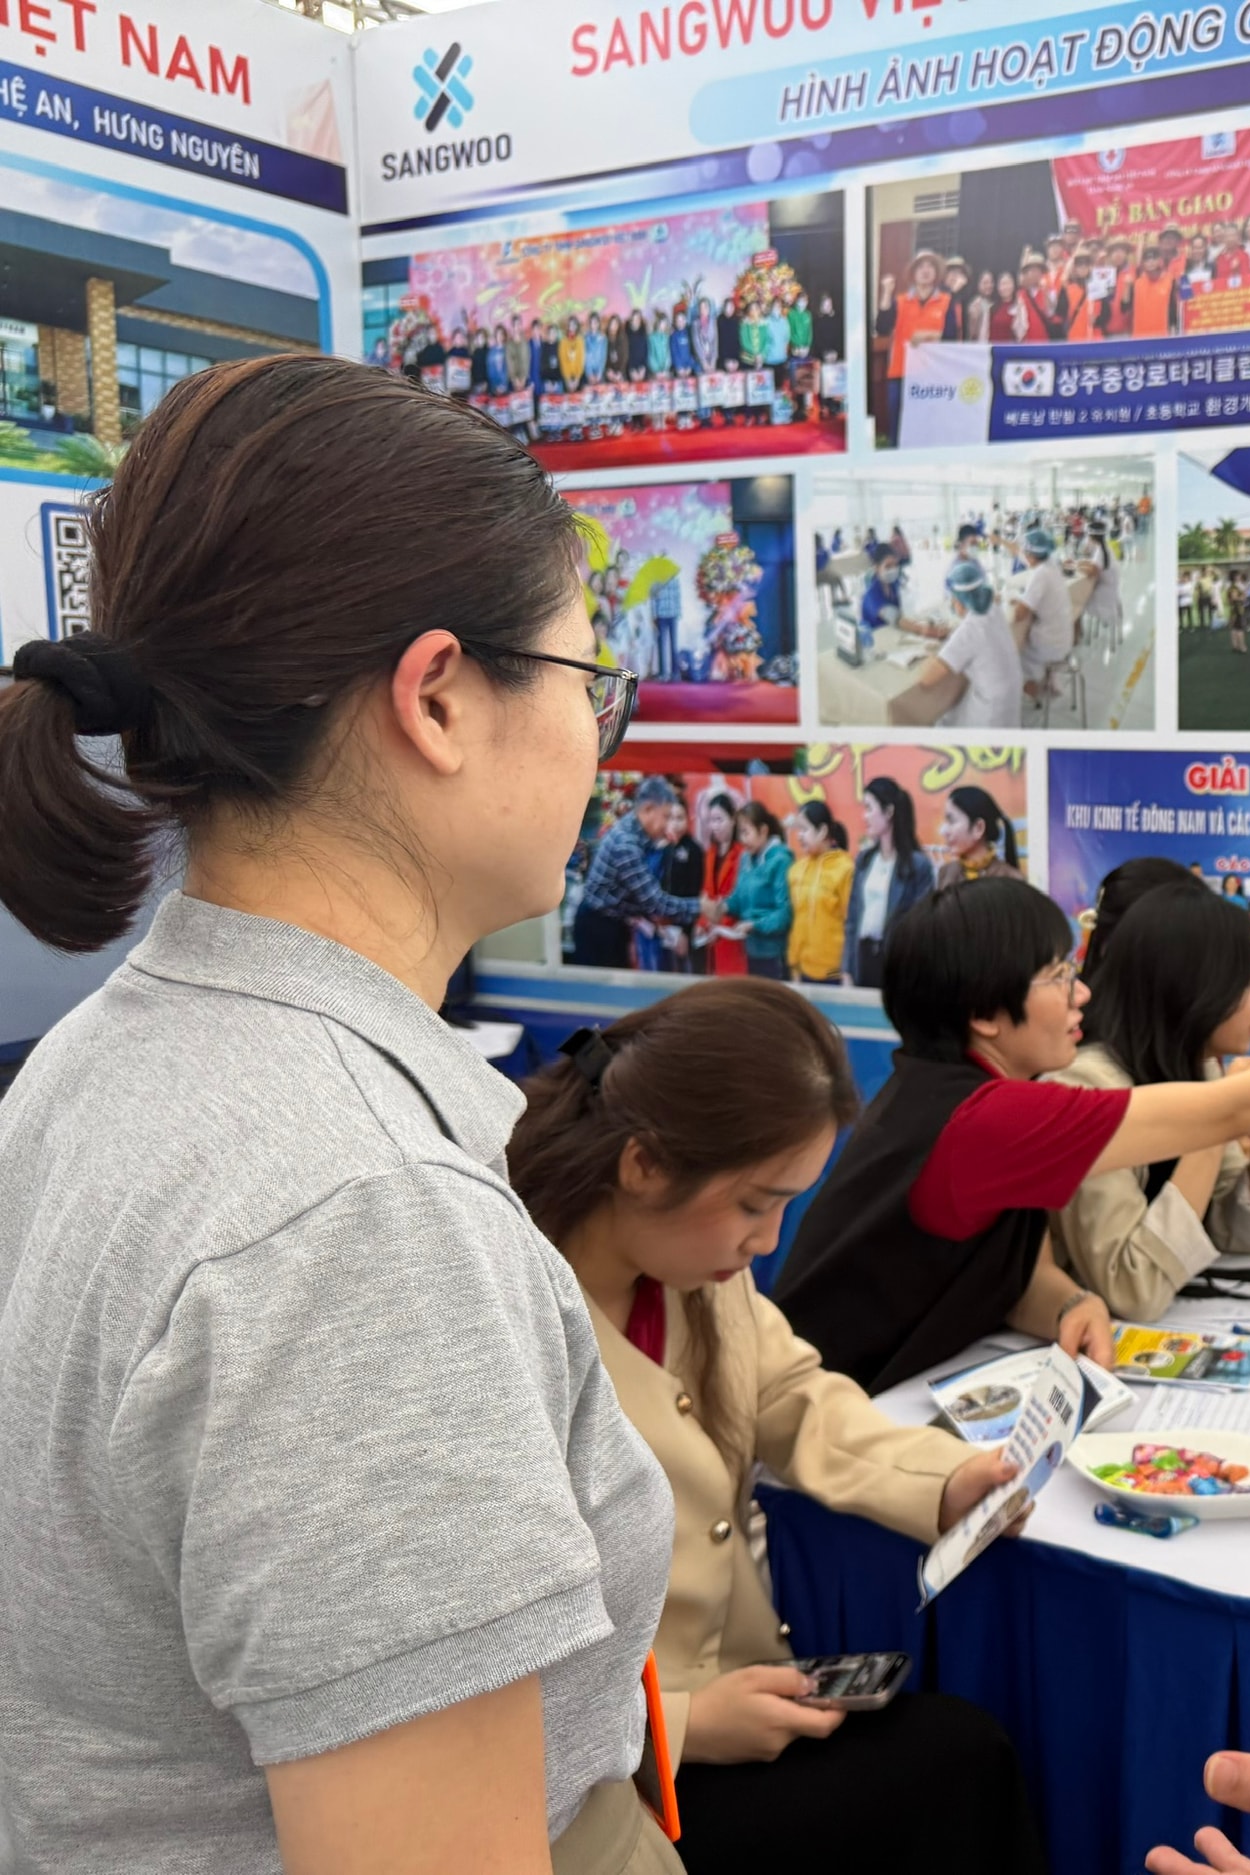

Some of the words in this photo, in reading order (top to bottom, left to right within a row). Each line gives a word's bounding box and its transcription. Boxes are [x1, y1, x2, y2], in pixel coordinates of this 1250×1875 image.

[119, 13, 252, 106] NAM
[779, 70, 868, 121] HÌNH
[877, 57, 960, 103] ẢNH
[971, 33, 1087, 88] HOẠT
[1094, 9, 1224, 70] ĐỘNG
[35, 90, 79, 131] AN,
[93, 106, 164, 150] HƯNG
[170, 129, 260, 179] NGUYÊN
[382, 133, 512, 181] SANGWOO
[1129, 195, 1173, 223] BÀN
[1176, 192, 1234, 217] GIAO
[910, 383, 957, 401] Rotary
[1186, 756, 1249, 794] GIẢI
[1067, 804, 1091, 829] KHU
[1093, 805, 1122, 830] KINH
[1124, 800, 1140, 831] TẾ
[1178, 809, 1206, 834] NAM
[1209, 806, 1224, 835] VÀ
